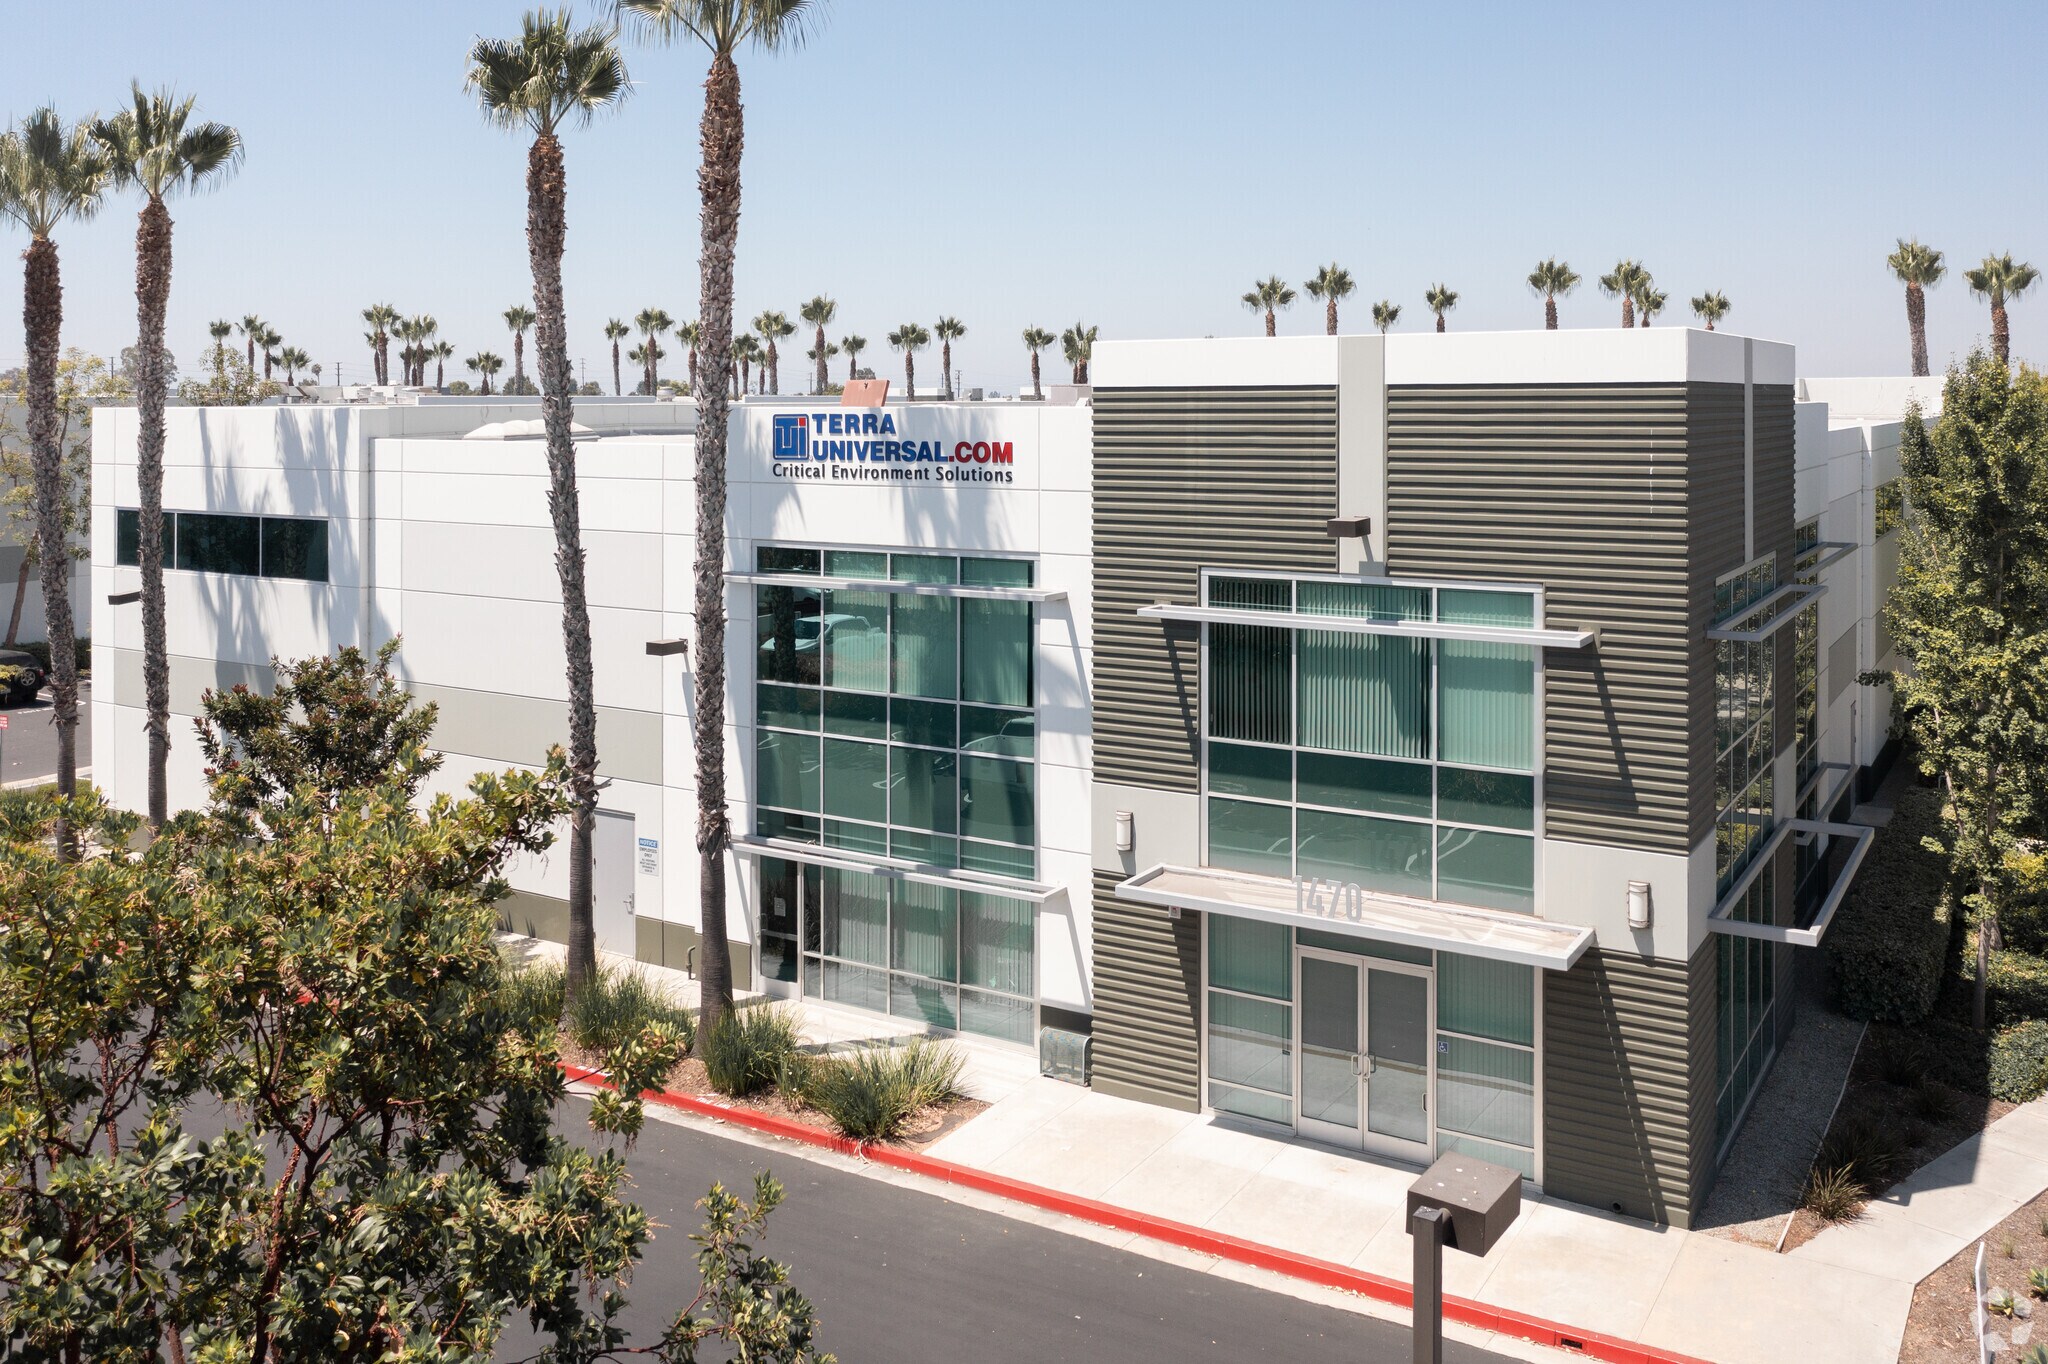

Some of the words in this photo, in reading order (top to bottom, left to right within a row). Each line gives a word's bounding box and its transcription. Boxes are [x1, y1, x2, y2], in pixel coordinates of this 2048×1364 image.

[812, 413, 896, 435] TERRA
[812, 440, 1013, 464] UNIVERSAL.COM
[772, 463, 825, 478] Critical
[831, 464, 930, 481] Environment
[935, 466, 1013, 483] Solutions
[640, 840, 657, 848] NOTICE
[1291, 874, 1362, 922] 1470
